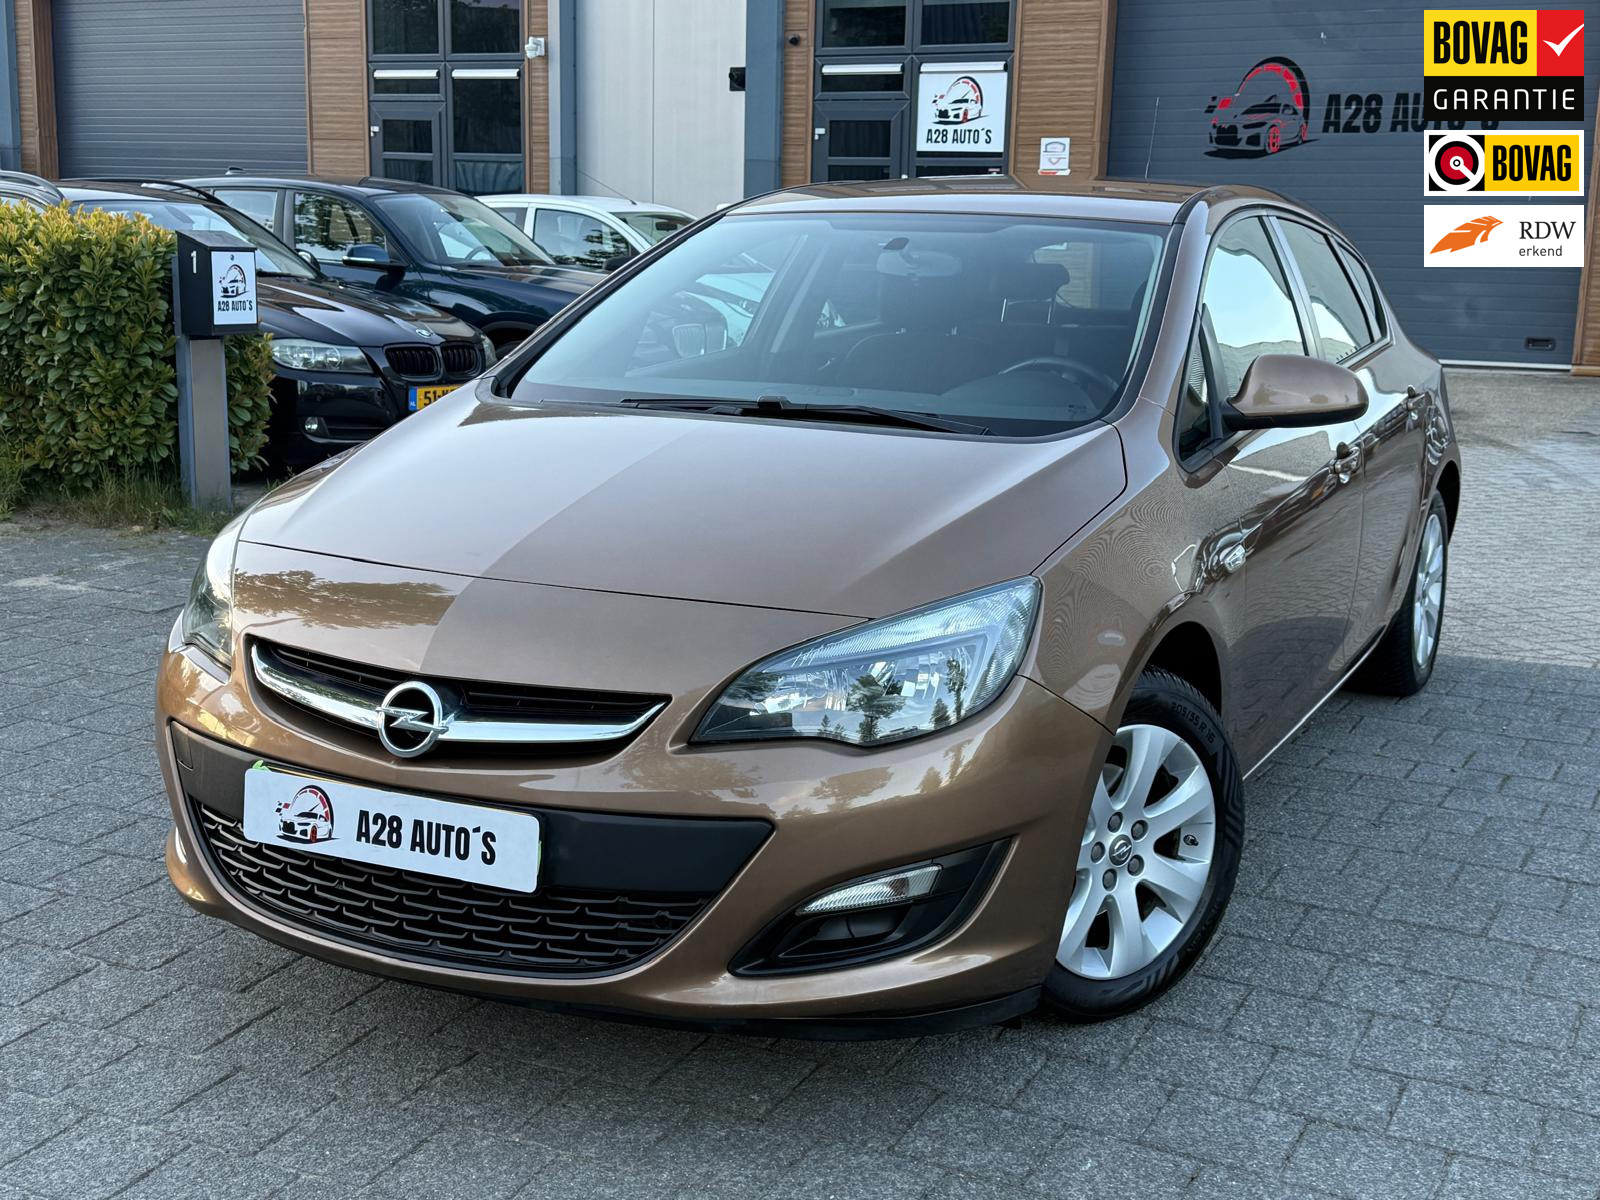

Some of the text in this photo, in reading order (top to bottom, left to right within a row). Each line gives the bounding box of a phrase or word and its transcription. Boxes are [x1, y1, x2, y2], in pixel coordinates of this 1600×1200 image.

[1322, 93, 1384, 134] A28
[926, 128, 948, 144] A28
[190, 250, 197, 274] 1
[217, 300, 230, 312] A28
[356, 809, 403, 849] A28
